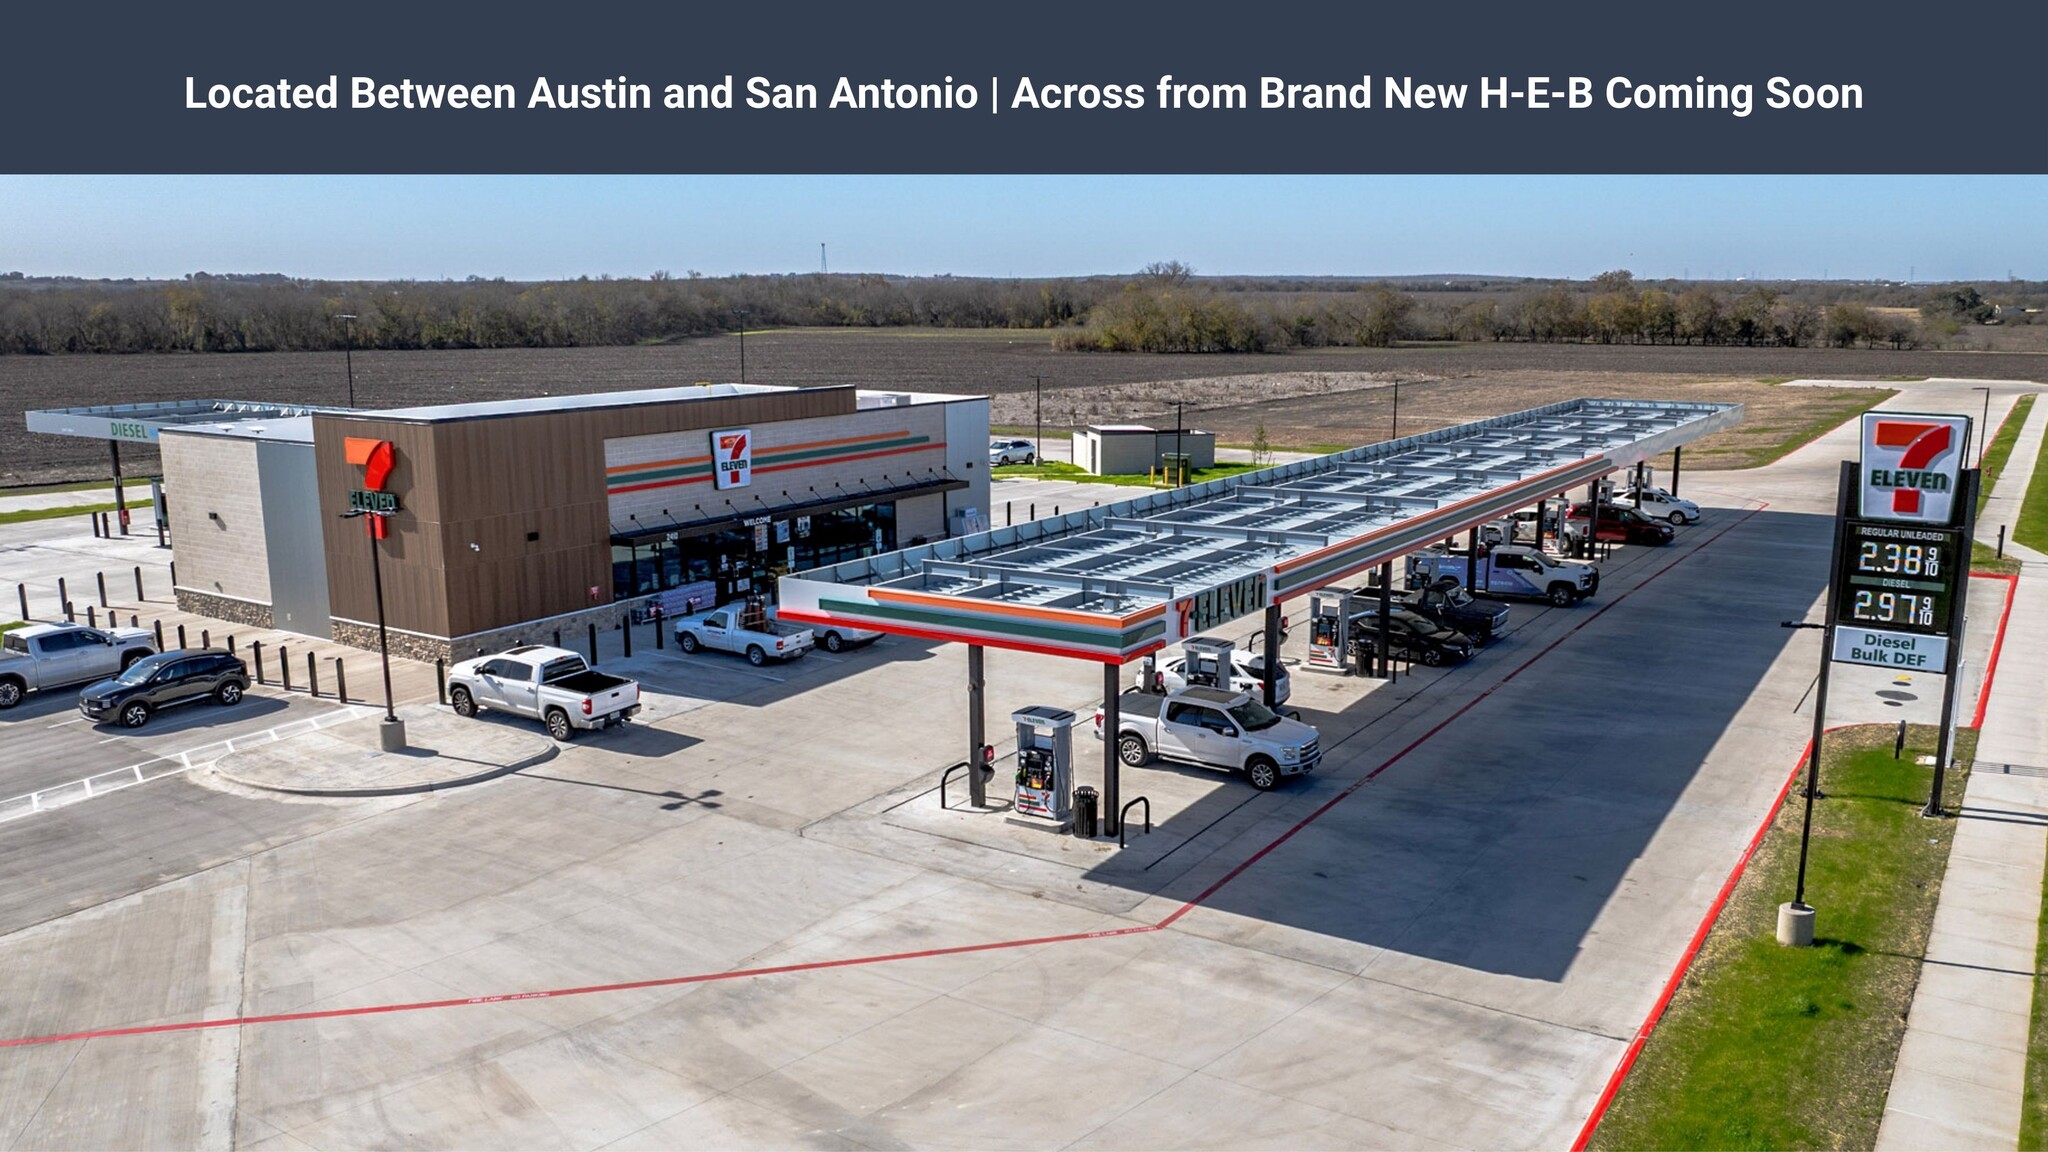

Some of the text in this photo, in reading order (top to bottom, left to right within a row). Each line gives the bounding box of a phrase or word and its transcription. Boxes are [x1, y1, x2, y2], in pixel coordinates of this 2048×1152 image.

[111, 422, 148, 439] DIESEL
[720, 434, 747, 484] 7
[1874, 421, 1951, 513] 7
[743, 515, 771, 527] WELCOME
[1861, 527, 1944, 541] REGULAR UNLEADED
[1859, 541, 1922, 575] 2.38
[1882, 578, 1911, 588] DIESEL
[1854, 590, 1916, 624] 2.97
[1864, 633, 1916, 651] Diesel
[1851, 647, 1927, 666] Bulk DEF
